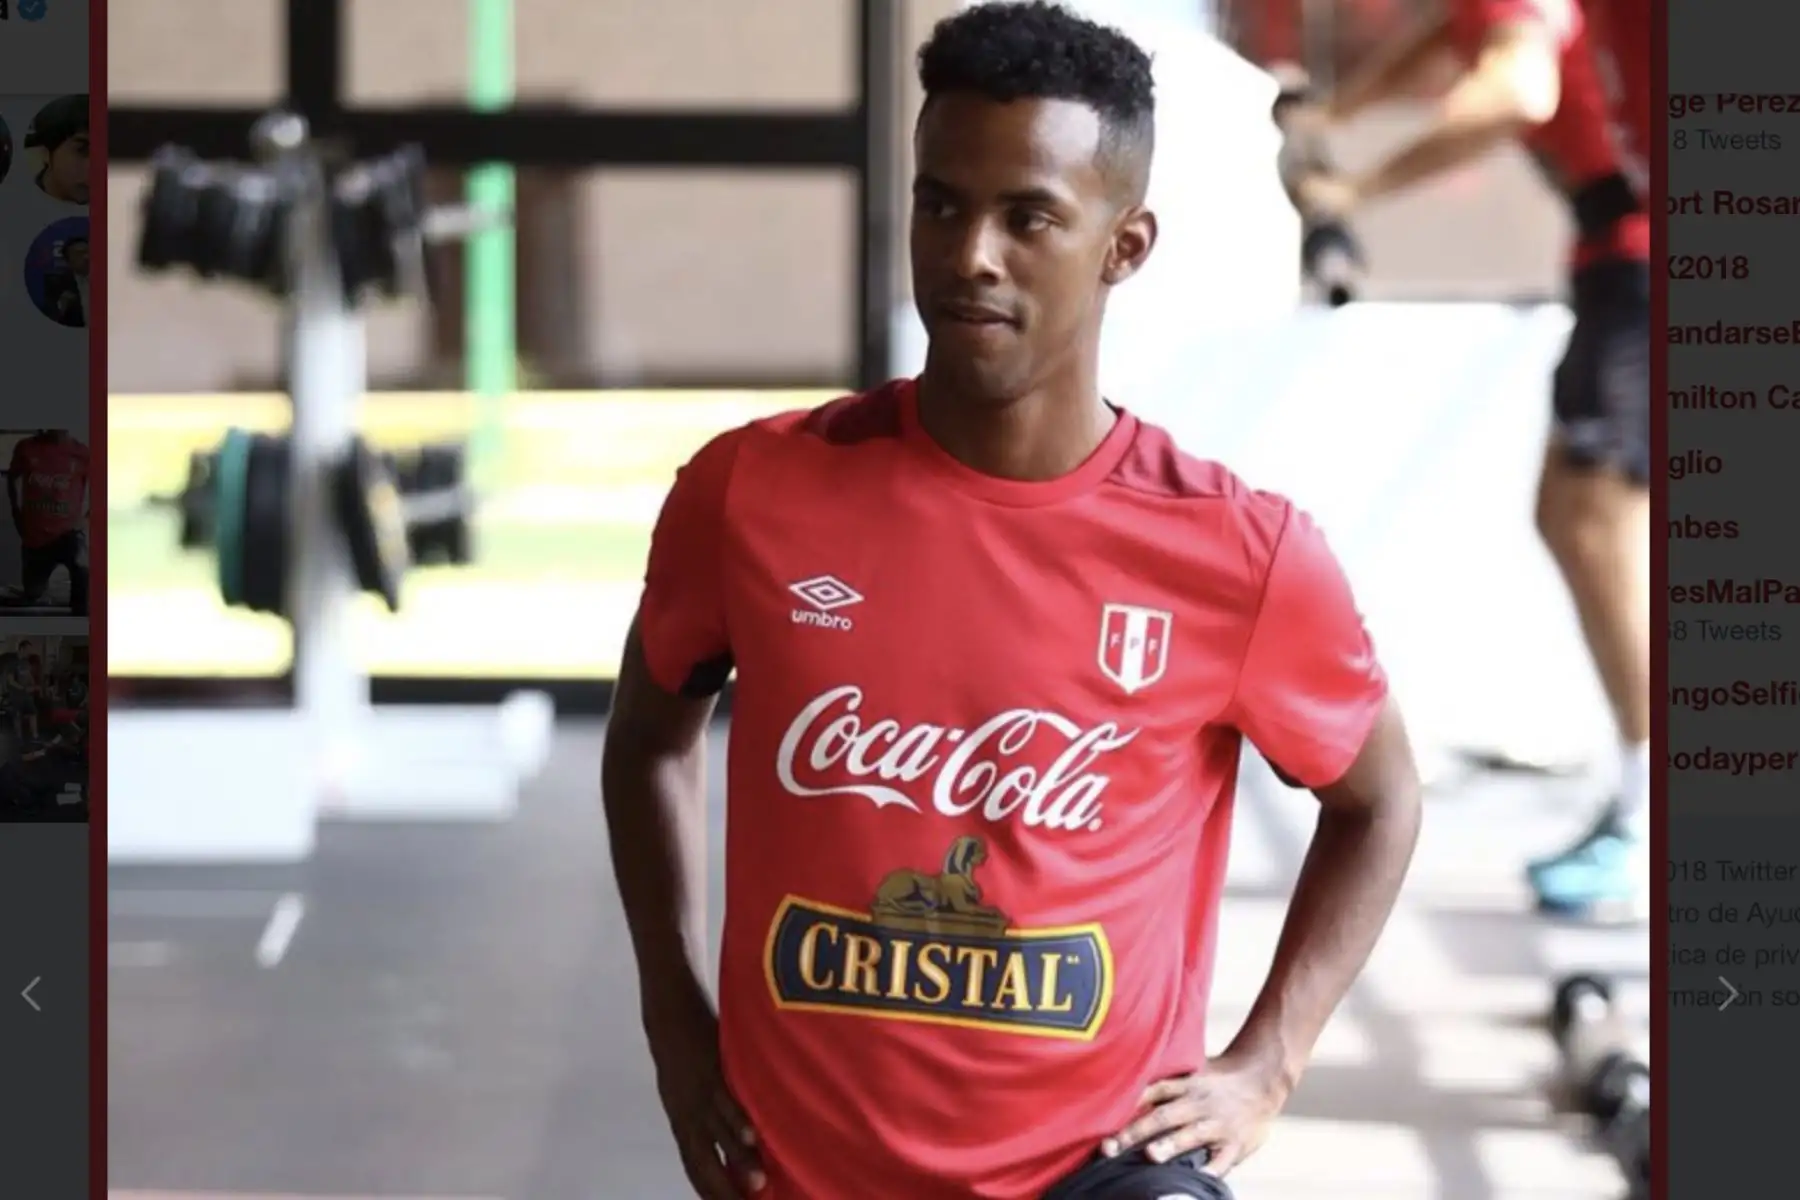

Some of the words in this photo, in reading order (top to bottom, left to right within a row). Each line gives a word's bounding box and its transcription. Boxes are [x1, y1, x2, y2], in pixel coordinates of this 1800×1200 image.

[1696, 129, 1782, 150] Tweets
[1667, 579, 1800, 604] esMalPa
[791, 609, 852, 631] umbro
[1696, 619, 1782, 641] Tweets
[776, 686, 1141, 831] Coca-Cola
[1715, 859, 1798, 882] Twitter
[1708, 902, 1739, 923] de
[1715, 943, 1746, 965] de
[801, 921, 1073, 1012] CRISTAL
